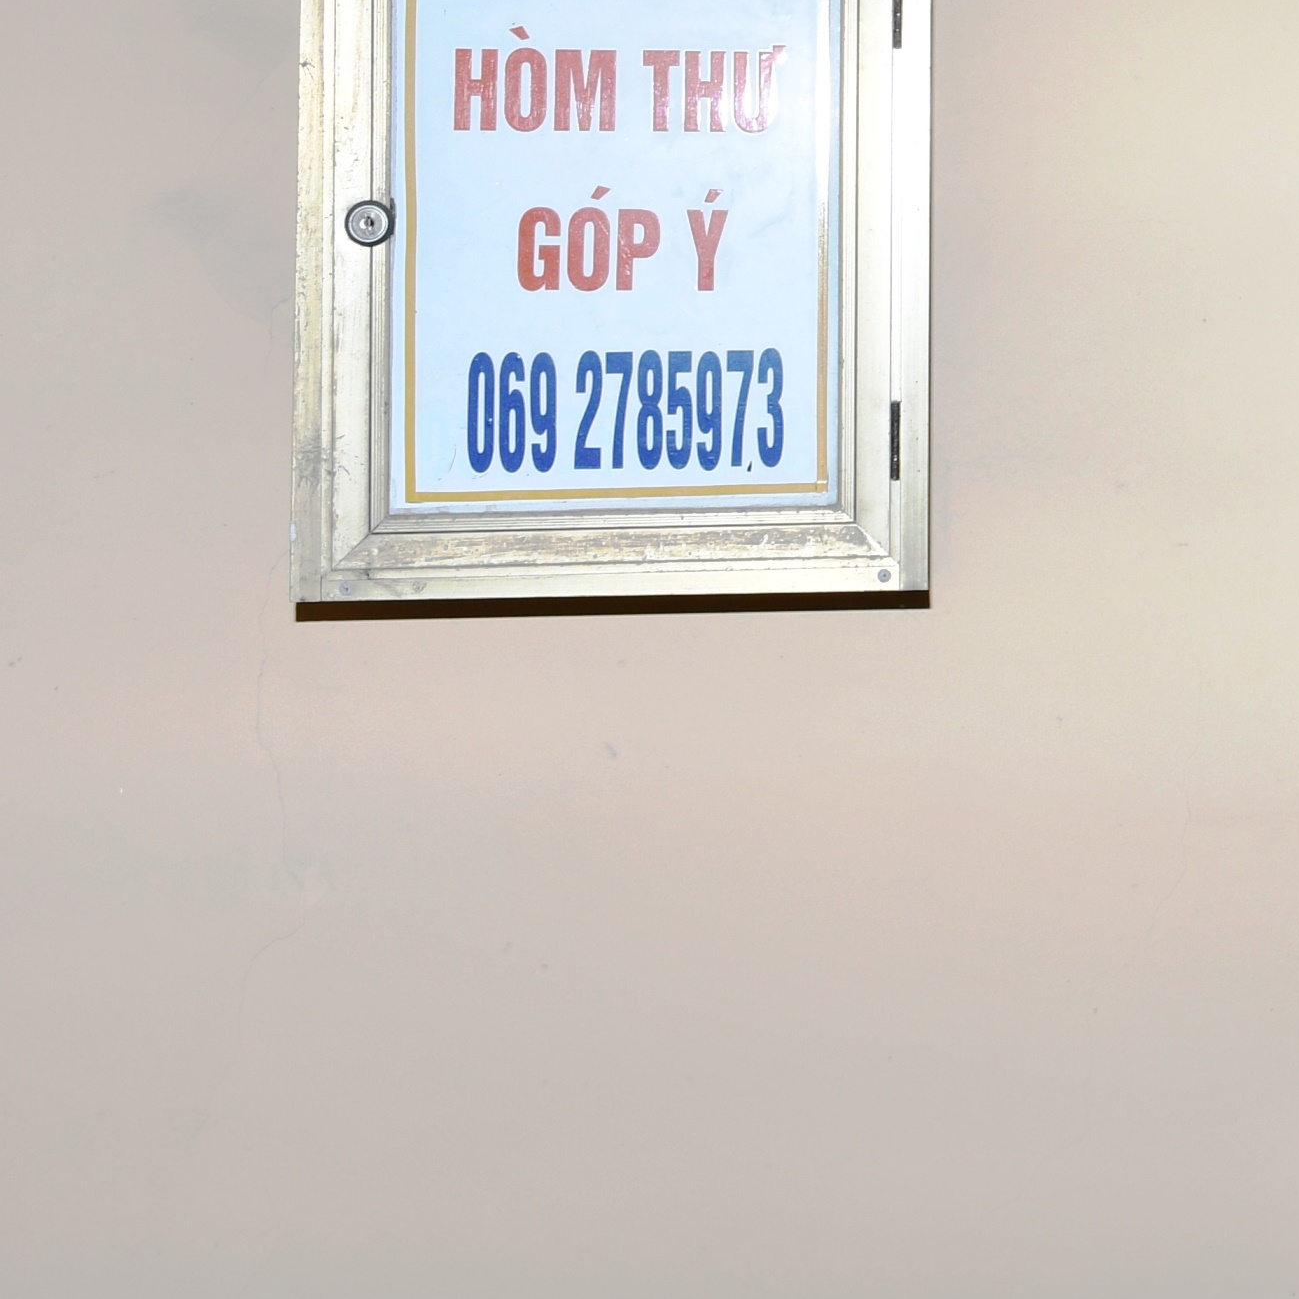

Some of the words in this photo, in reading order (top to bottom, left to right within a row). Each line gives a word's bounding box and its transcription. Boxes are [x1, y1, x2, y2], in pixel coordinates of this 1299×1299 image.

[454, 26, 617, 131] HÒM
[643, 45, 787, 133] THƯ
[517, 186, 660, 292] GÓP
[687, 189, 729, 291] Ý
[467, 351, 556, 473] 069
[574, 348, 785, 471] 2785973
